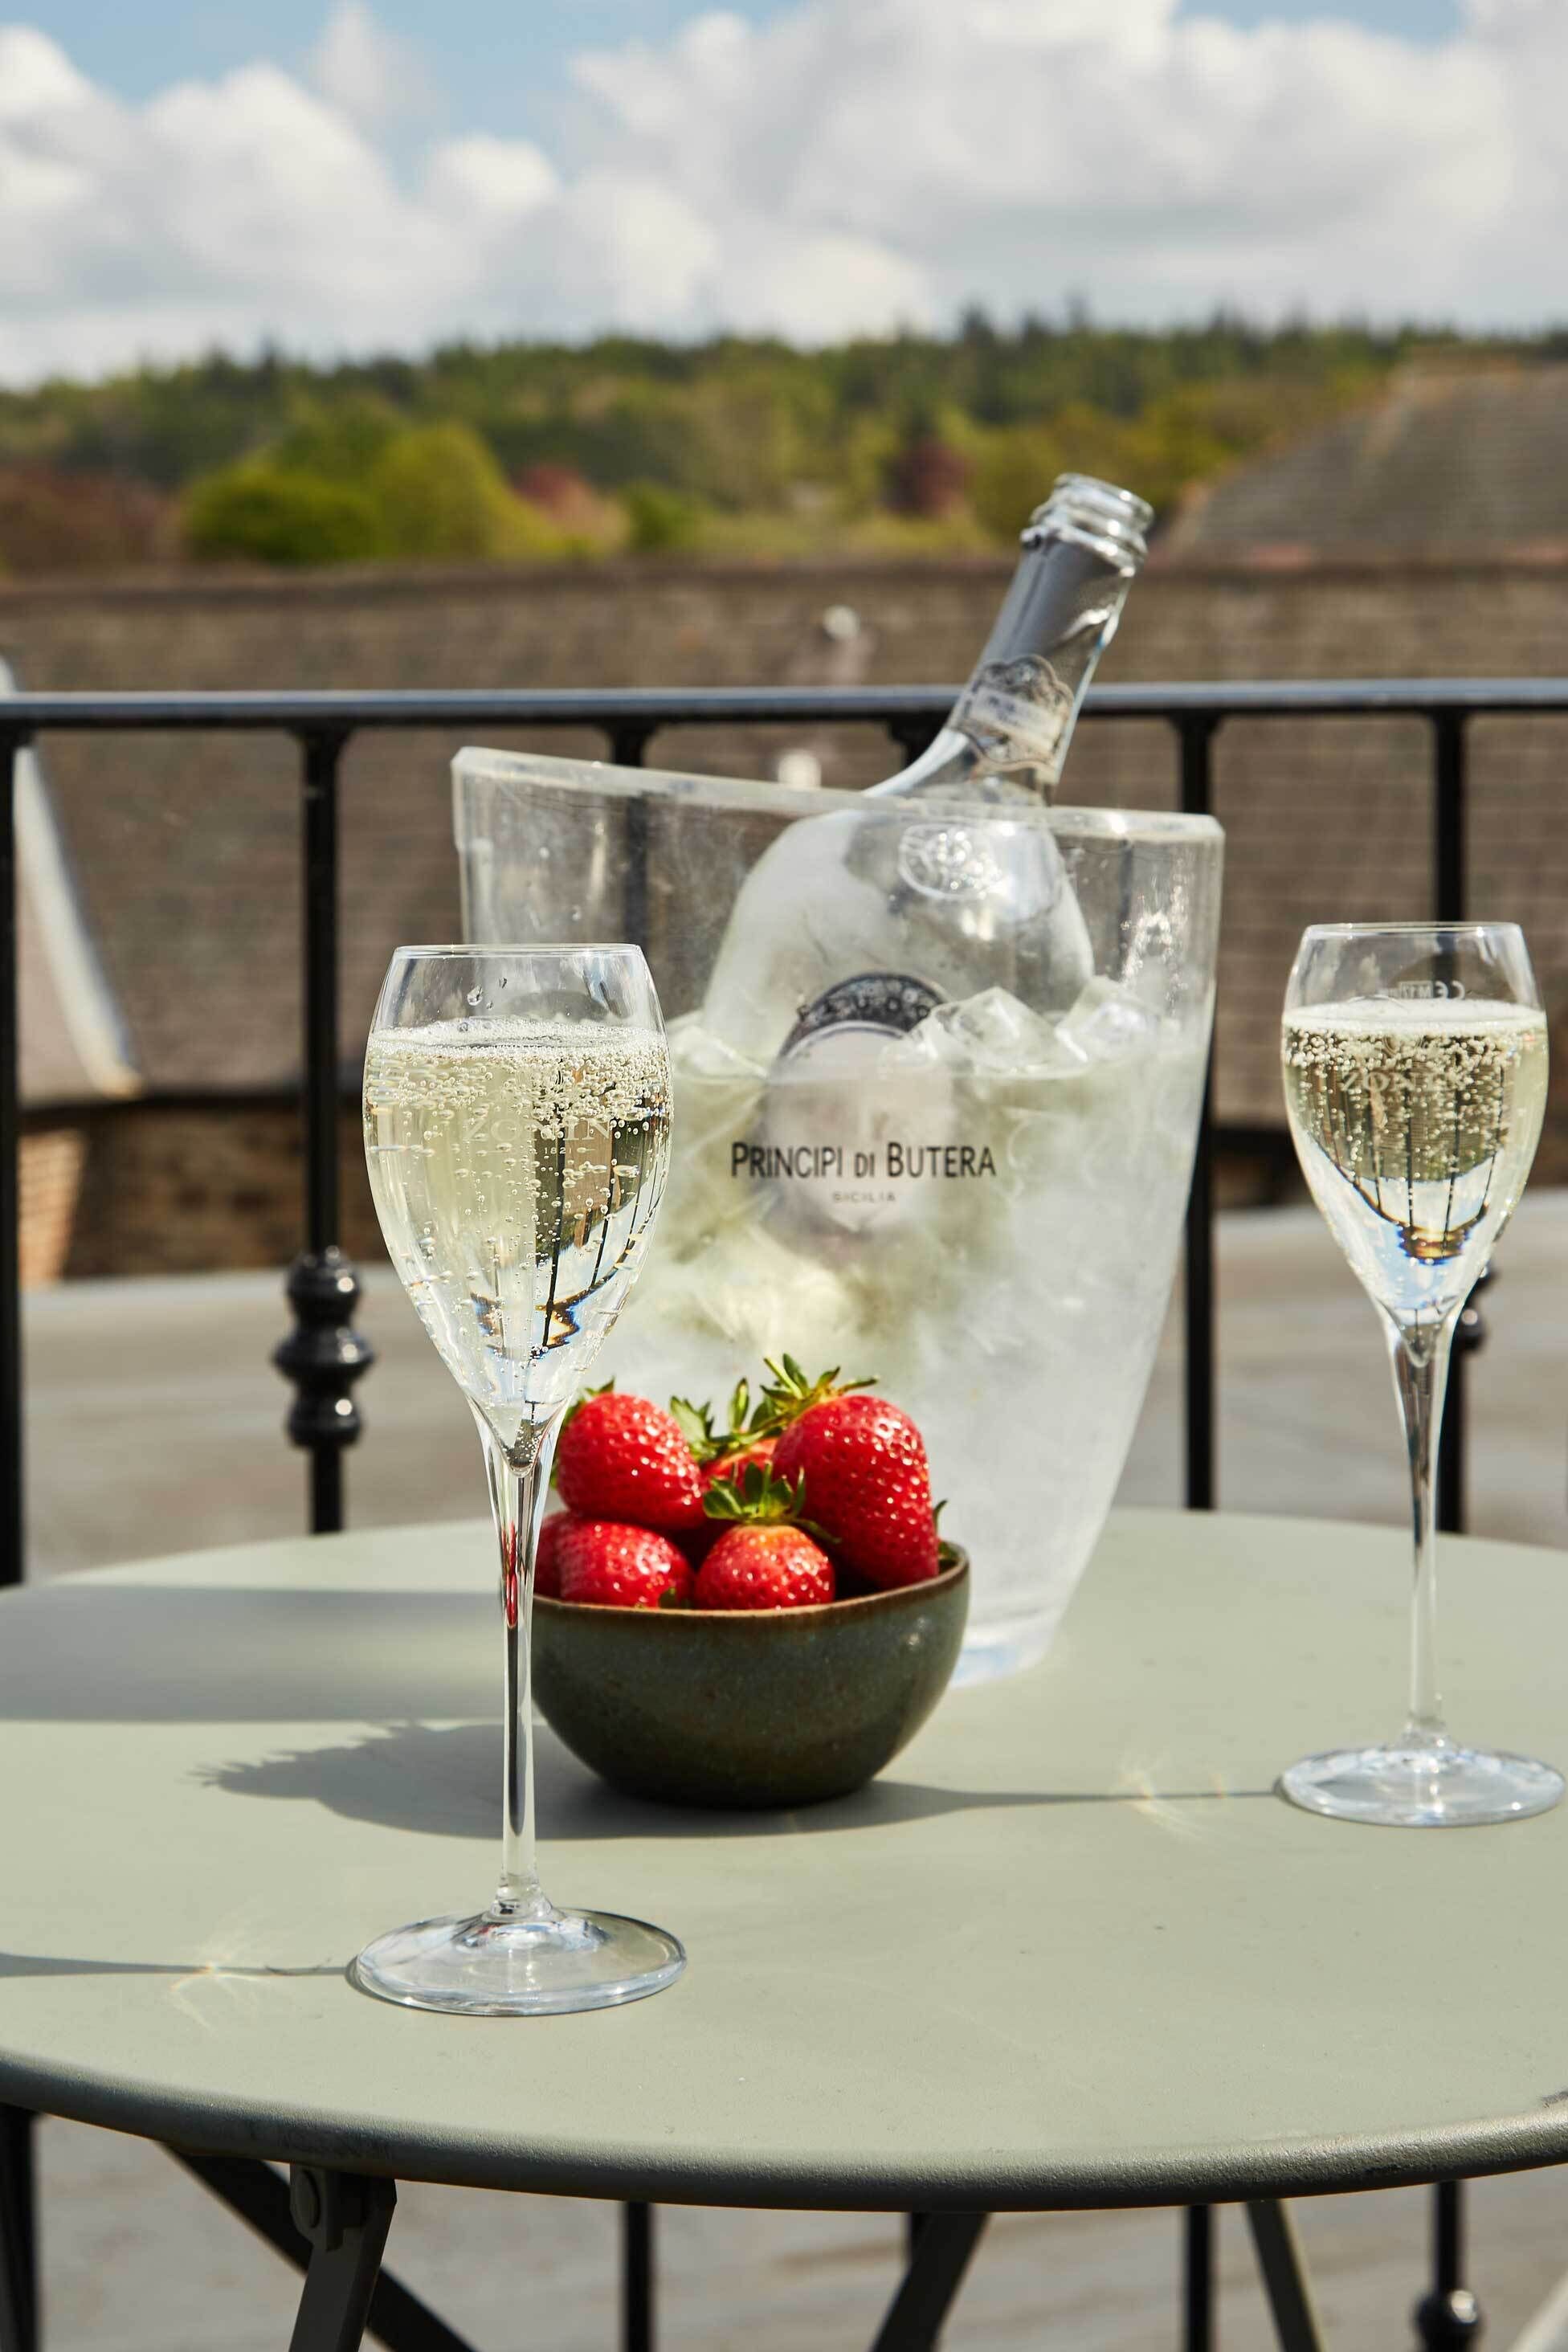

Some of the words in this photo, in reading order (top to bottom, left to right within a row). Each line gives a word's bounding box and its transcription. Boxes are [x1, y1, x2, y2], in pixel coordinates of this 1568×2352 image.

[544, 1146, 572, 1154] 1821
[731, 1141, 843, 1178] PRINCIPI
[887, 1141, 997, 1178] BUTERA
[832, 1190, 896, 1203] SICILIA
